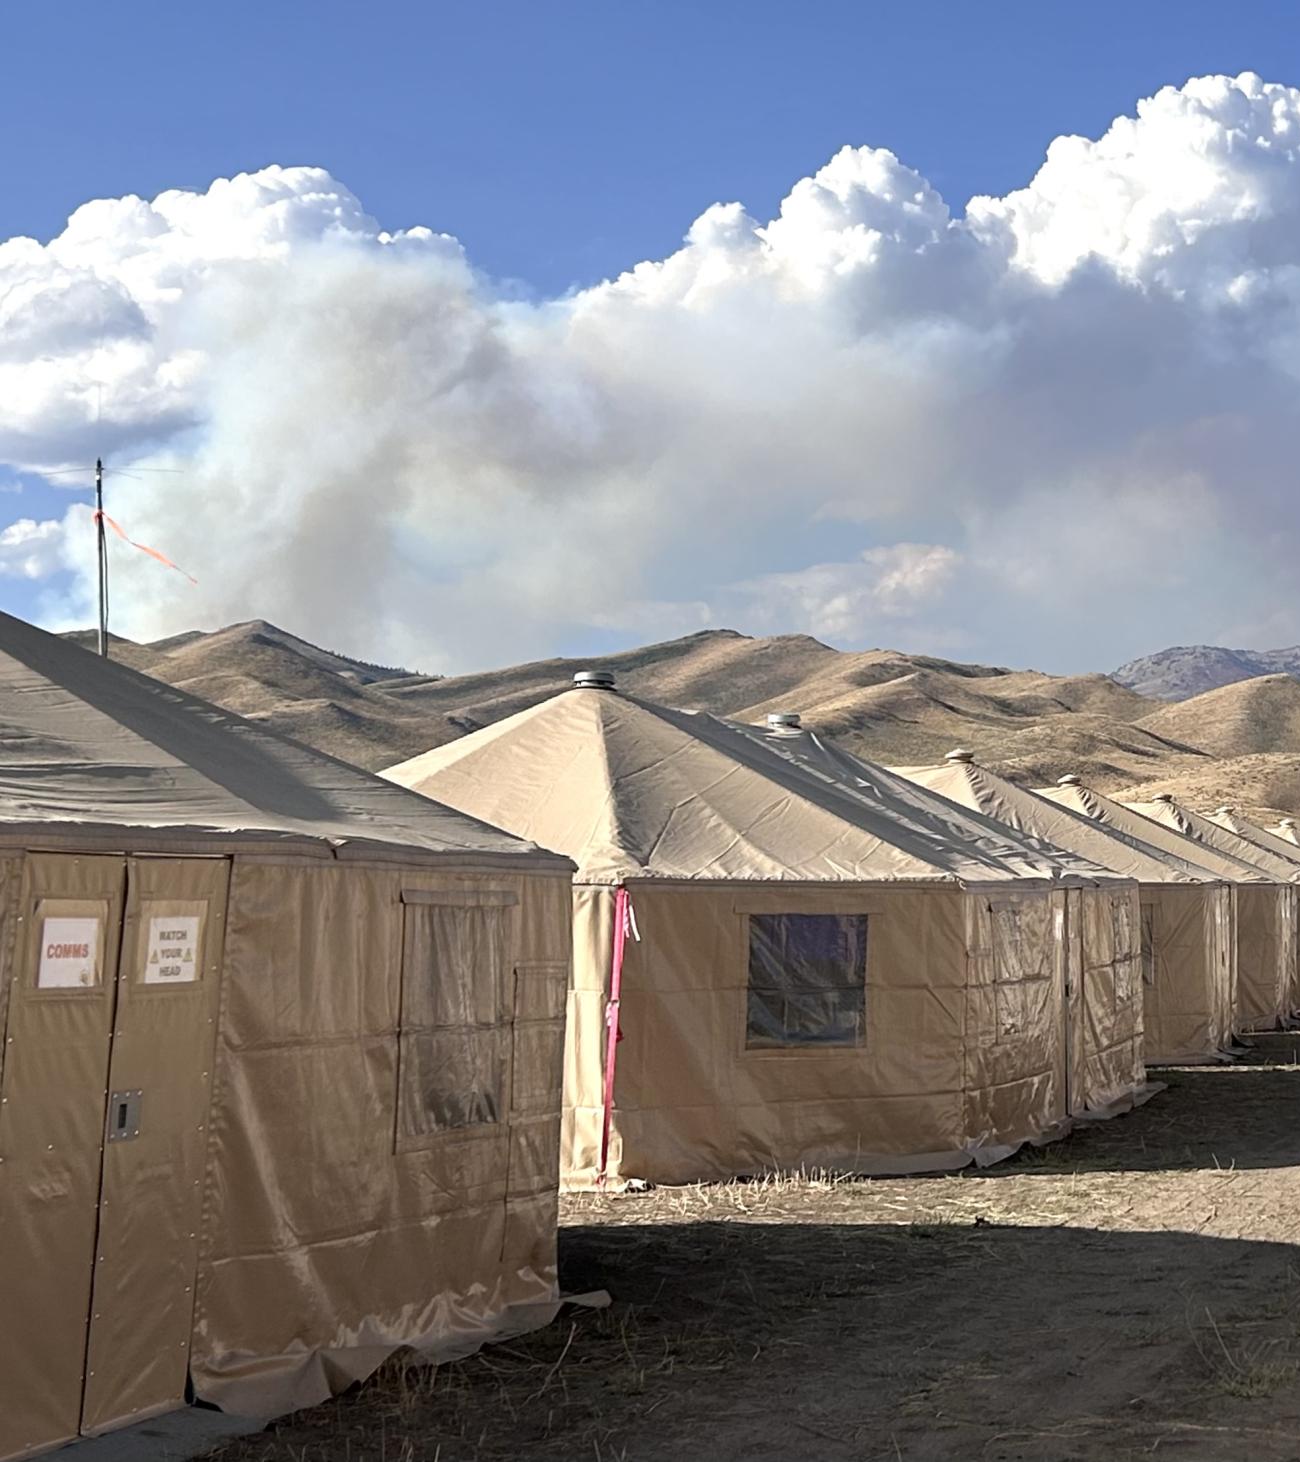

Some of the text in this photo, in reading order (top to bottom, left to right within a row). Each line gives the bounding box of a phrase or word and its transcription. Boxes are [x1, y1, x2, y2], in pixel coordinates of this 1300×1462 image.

[159, 930, 188, 941] WATCH
[47, 943, 89, 959] COMMS
[161, 948, 182, 959] YOUR
[159, 965, 182, 977] HEAD
